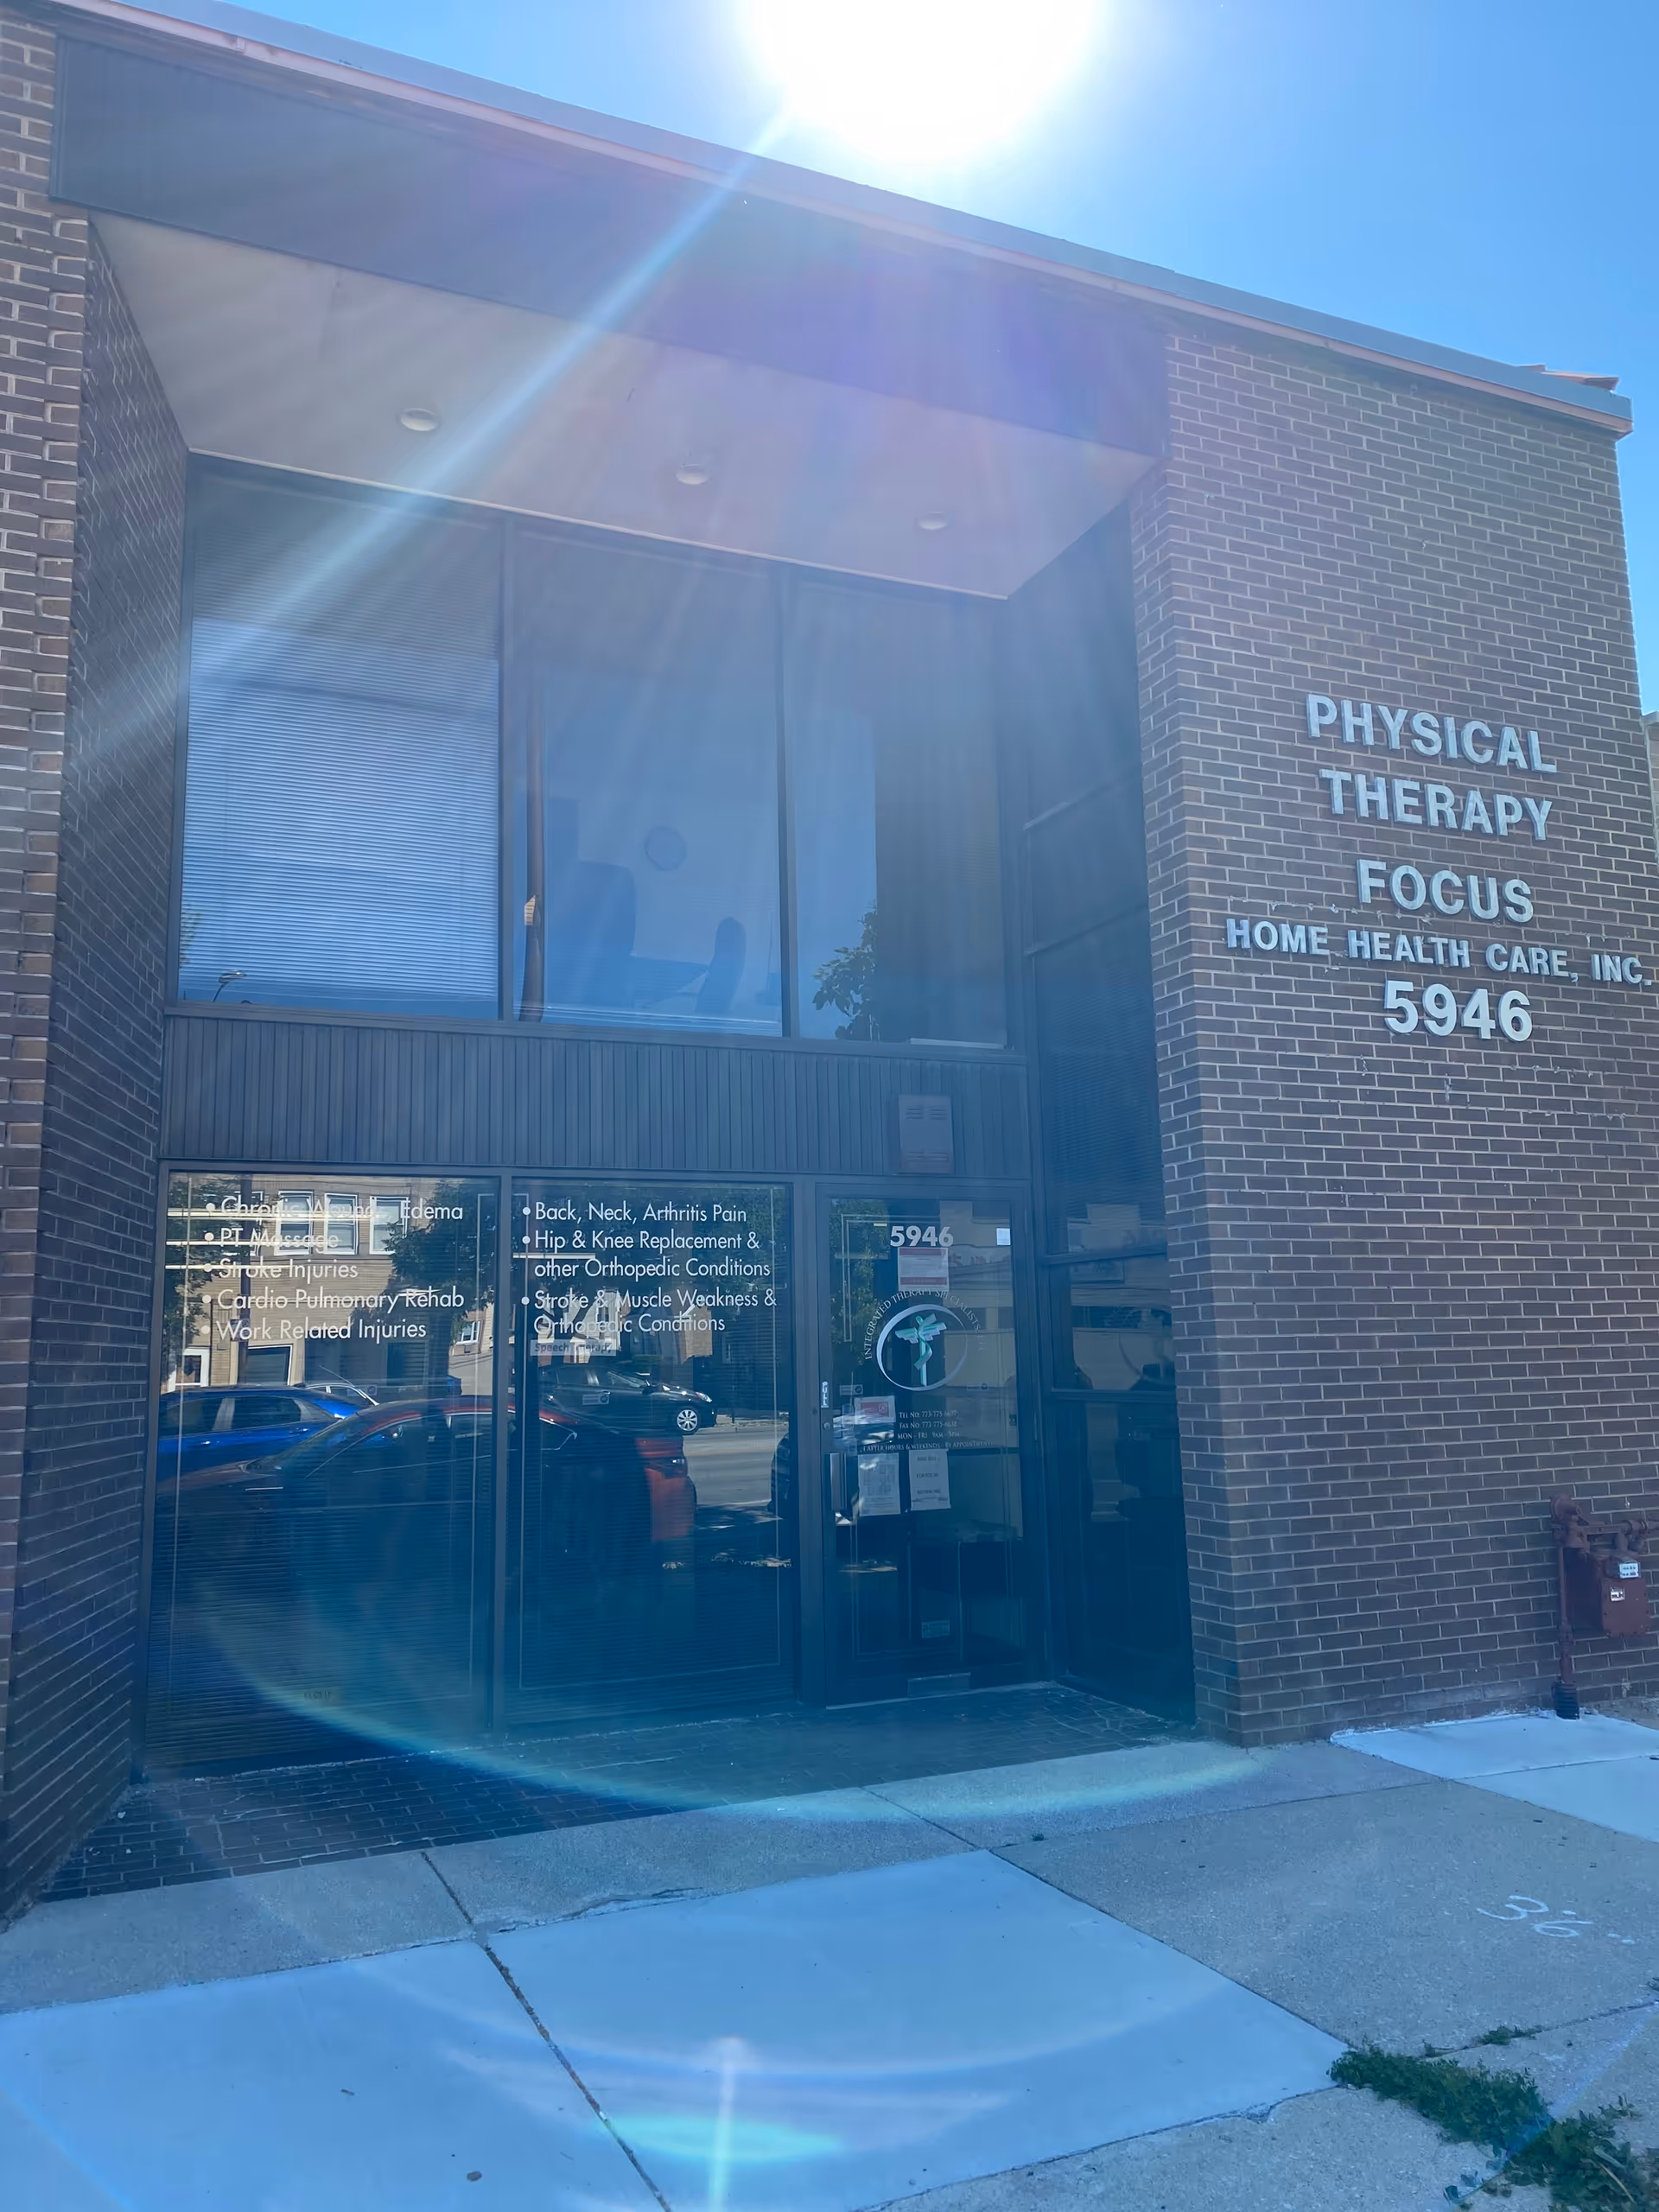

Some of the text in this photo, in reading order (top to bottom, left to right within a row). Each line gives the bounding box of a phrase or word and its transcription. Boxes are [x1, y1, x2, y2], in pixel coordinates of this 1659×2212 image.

[1306, 694, 1557, 774] PHYSICAL
[1319, 769, 1553, 841] THERAPY
[1357, 859, 1534, 923] FOCUS
[1226, 918, 1652, 986] HOME HEALTH CARE, INC.
[1384, 980, 1533, 1042] 5946
[220, 1196, 300, 1218] Chronic
[400, 1198, 464, 1220] Edema
[535, 1199, 747, 1224] Back, Neck, Arthritis Pain
[219, 1227, 340, 1255] PT Massage
[535, 1229, 760, 1255] Hip & Knee Replacement &
[890, 1226, 954, 1248] 5946
[219, 1257, 359, 1285] Stroke Injuries
[534, 1255, 771, 1282] other Orthopedic Conditions
[217, 1285, 465, 1314] Cardio Pulmonary Rehab
[534, 1286, 778, 1310] Stroke & Muscle Weakness &
[216, 1317, 427, 1344] Work Related Injuries
[533, 1313, 726, 1338] Orthopedic Conditions
[863, 1287, 982, 1360] INTEGRATED THERAPY SPECIALISTS
[534, 1342, 569, 1354] Speech
[897, 1431, 912, 1440] MON
[918, 1431, 928, 1440] FRI
